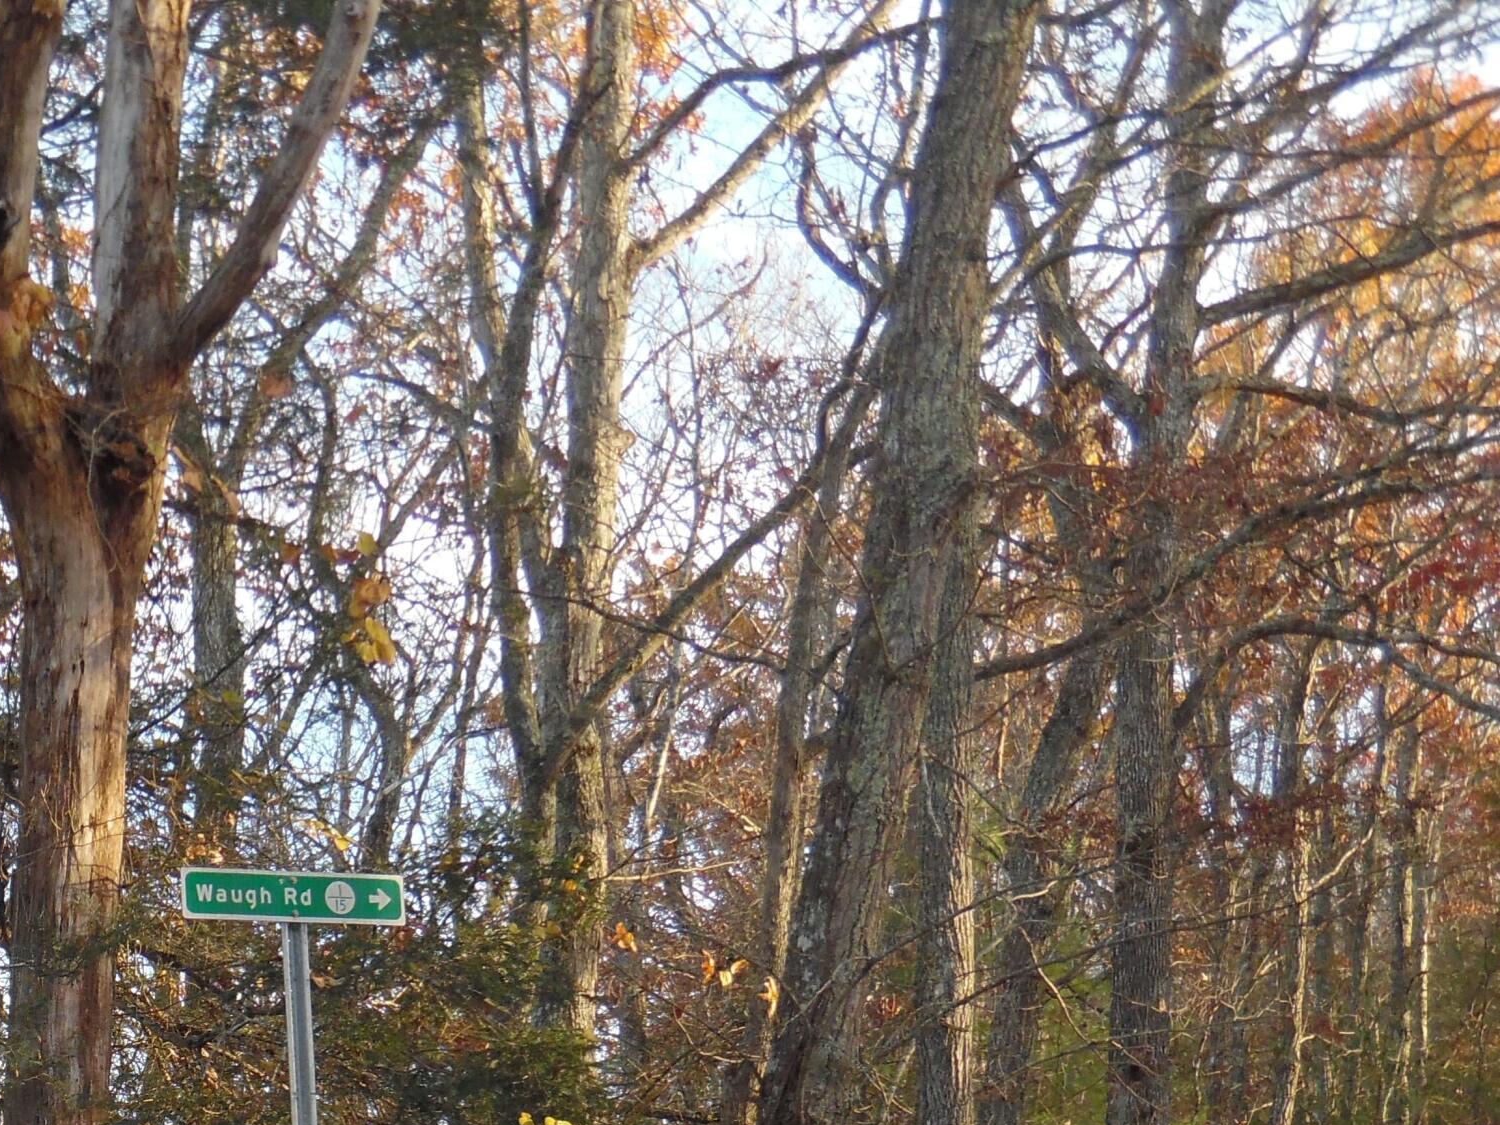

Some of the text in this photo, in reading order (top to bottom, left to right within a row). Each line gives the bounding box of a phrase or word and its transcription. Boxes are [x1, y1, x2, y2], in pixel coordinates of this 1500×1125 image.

[195, 883, 312, 909] Waugh Rd
[334, 899, 347, 912] 15
